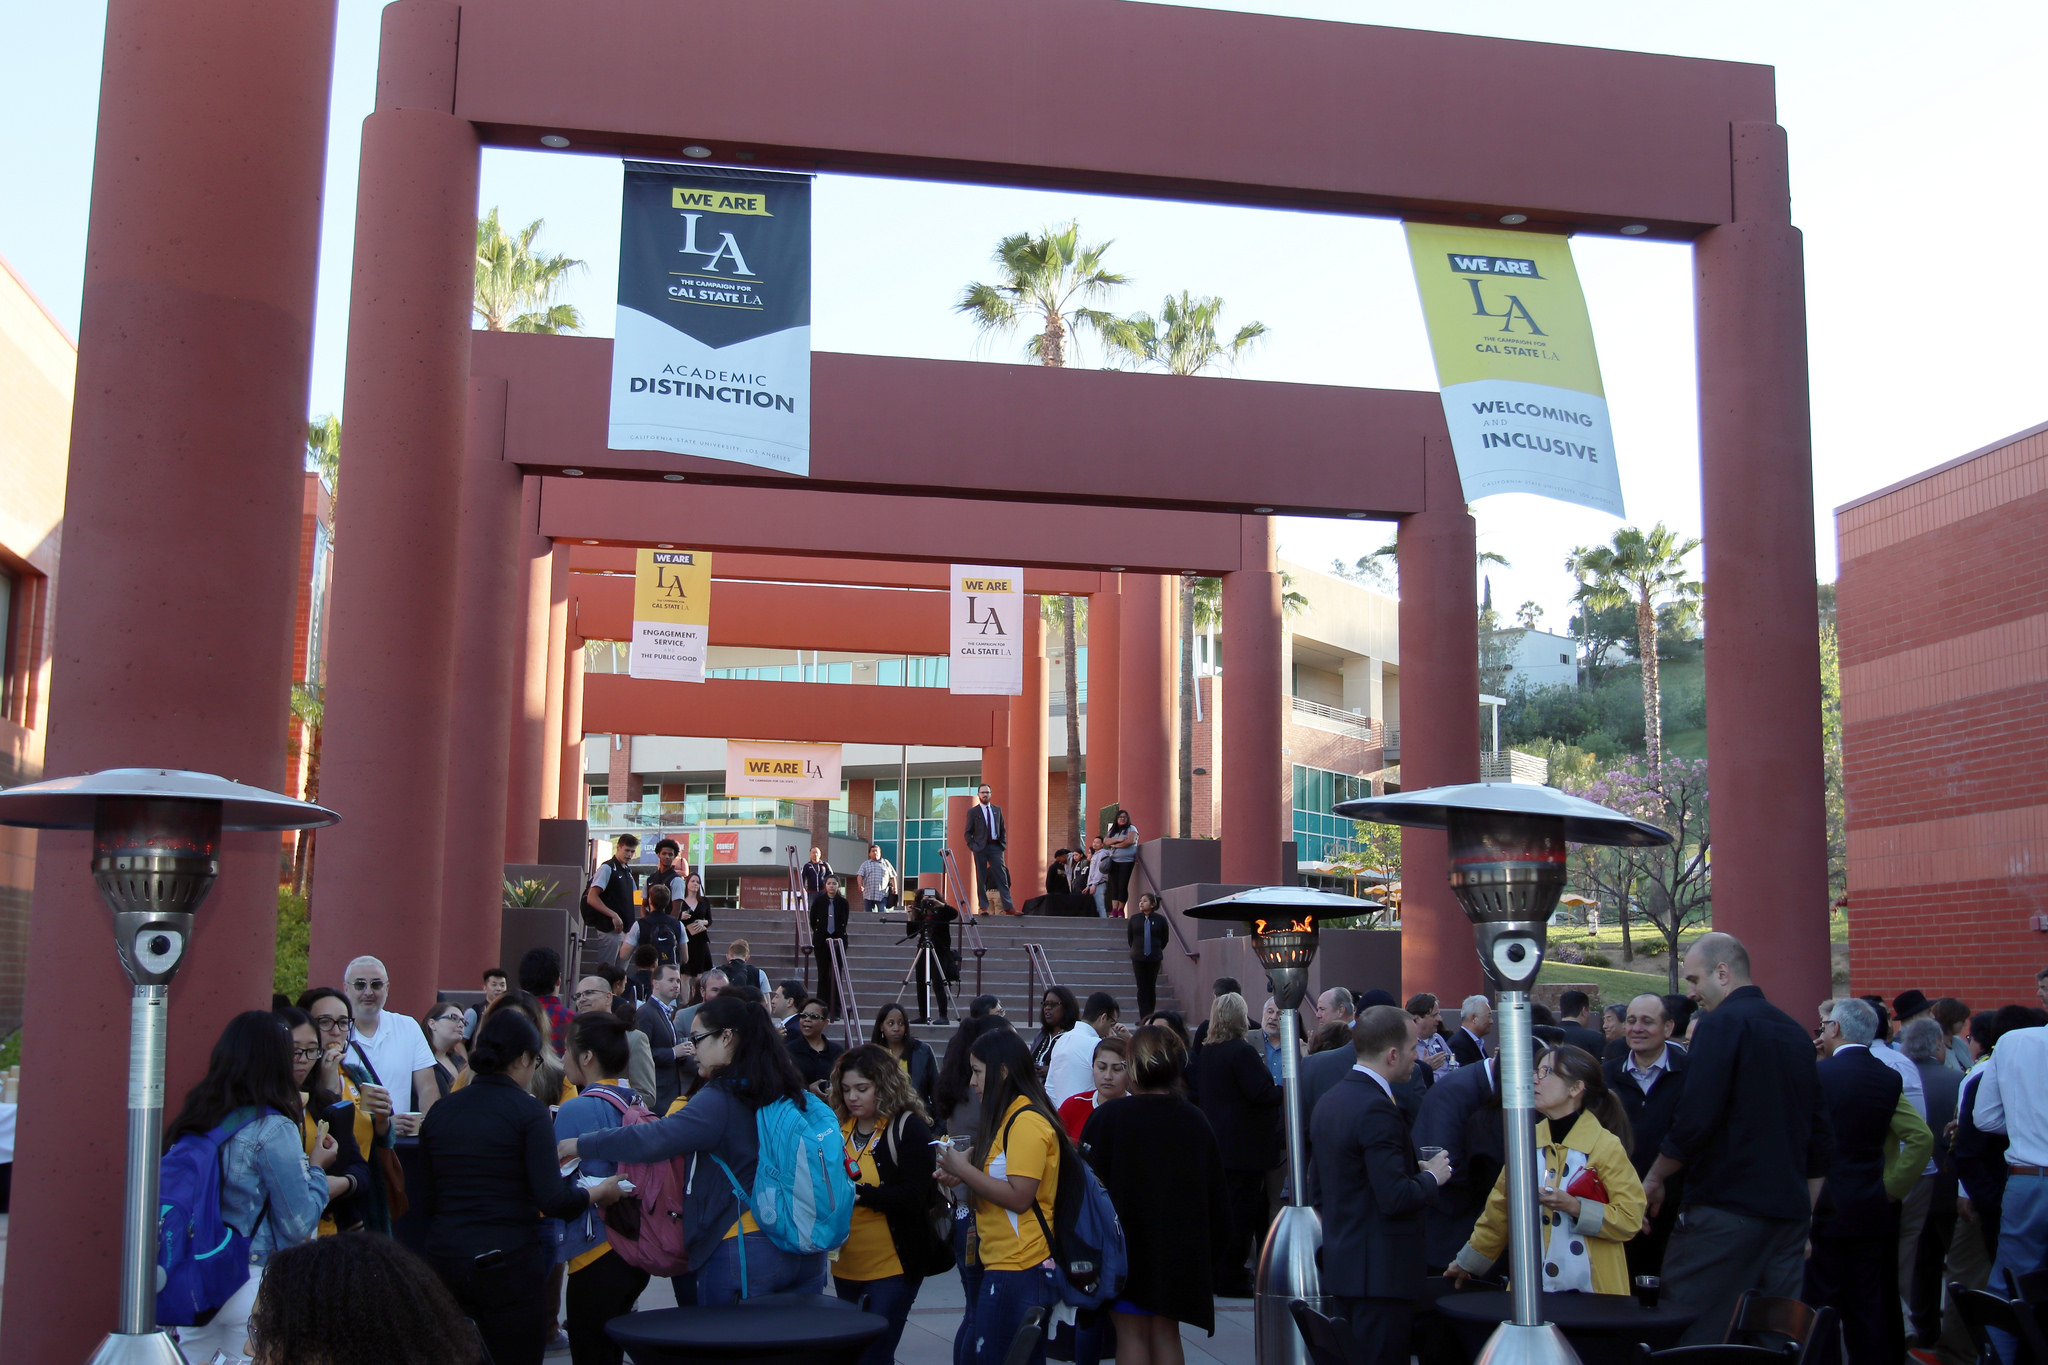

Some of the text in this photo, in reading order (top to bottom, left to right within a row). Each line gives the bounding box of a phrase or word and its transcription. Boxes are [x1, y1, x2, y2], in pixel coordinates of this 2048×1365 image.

[680, 193, 757, 210] WE ARE
[679, 214, 756, 276] LA
[1454, 257, 1531, 275] WE ARE
[696, 280, 734, 290] CAMPAIGN
[669, 286, 763, 306] CAL STATE LA
[1463, 278, 1549, 336] LA
[1497, 337, 1532, 346] CAMPAIGN
[1476, 344, 1560, 361] CAL STATE LA
[662, 364, 767, 386] ACADEMIC
[630, 377, 794, 414] DISTINCTION
[1472, 401, 1592, 427] WELCOMING
[762, 451, 791, 462] ANGELES
[1482, 433, 1598, 463] INCLUSIVE
[656, 554, 690, 563] WE ARE
[656, 567, 687, 598] LA
[966, 581, 1007, 590] WE ARE
[966, 596, 1007, 635] LA
[643, 629, 697, 640] ENGAGEMENT,
[654, 639, 685, 647] SERVICE,
[749, 762, 798, 774] WE ARE
[806, 760, 823, 778] LA
